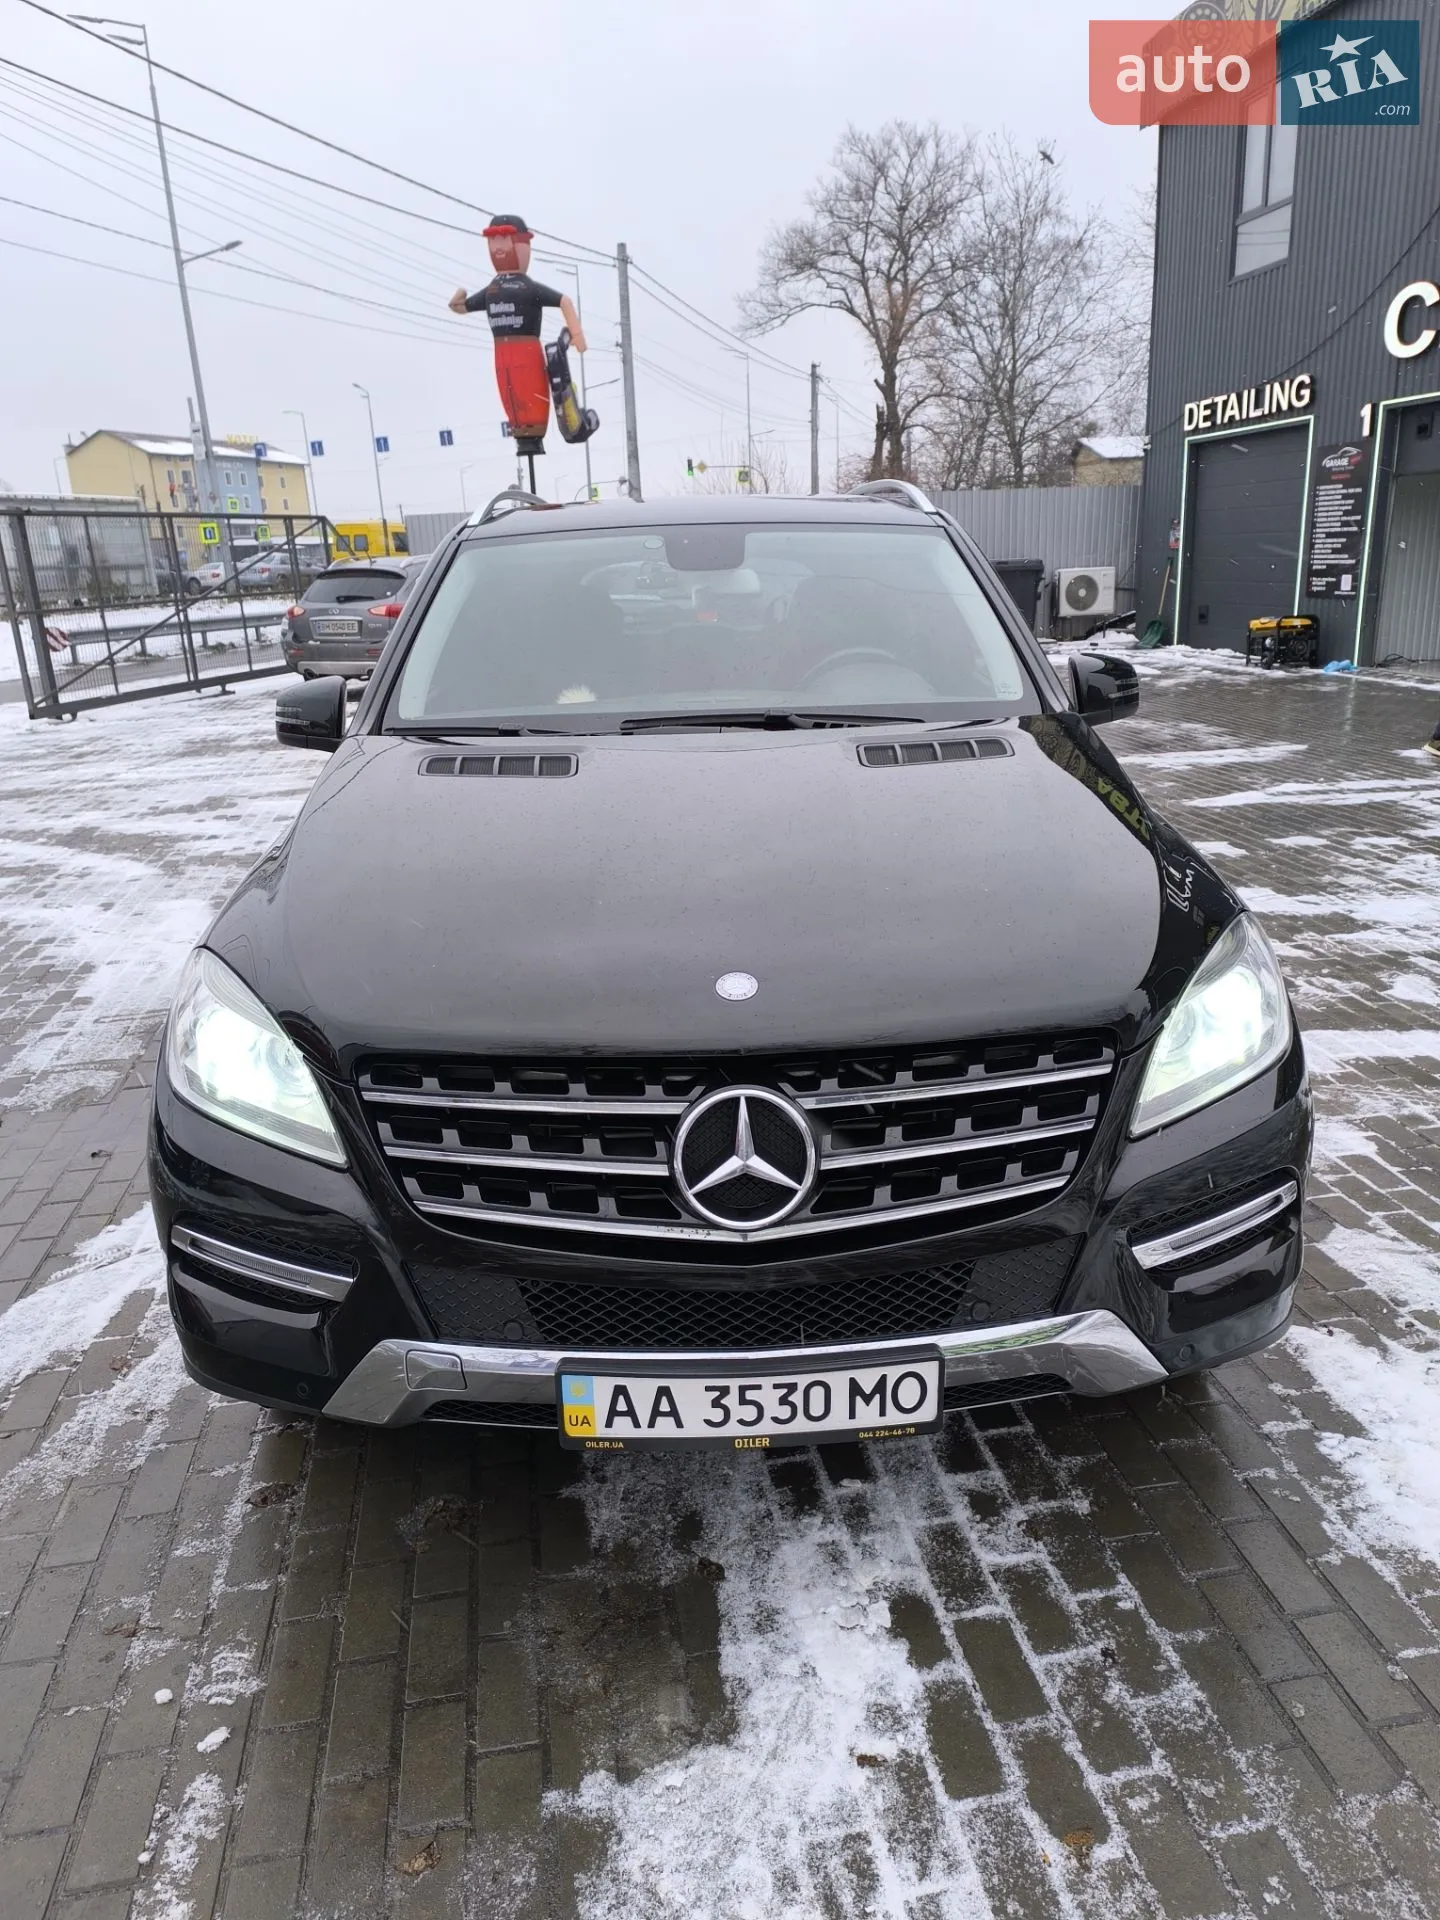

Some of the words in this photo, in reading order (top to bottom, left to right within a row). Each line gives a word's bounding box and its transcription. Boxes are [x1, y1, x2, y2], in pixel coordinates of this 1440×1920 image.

[1184, 374, 1312, 431] DETAILING
[1360, 403, 1373, 437] 1
[604, 1384, 684, 1429] AA
[703, 1380, 832, 1429] 3530
[848, 1370, 928, 1420] MO
[569, 1414, 592, 1428] UA
[875, 1427, 915, 1437] 224-46-78
[585, 1440, 624, 1449] OILER.UA
[734, 1437, 770, 1448] OILER
